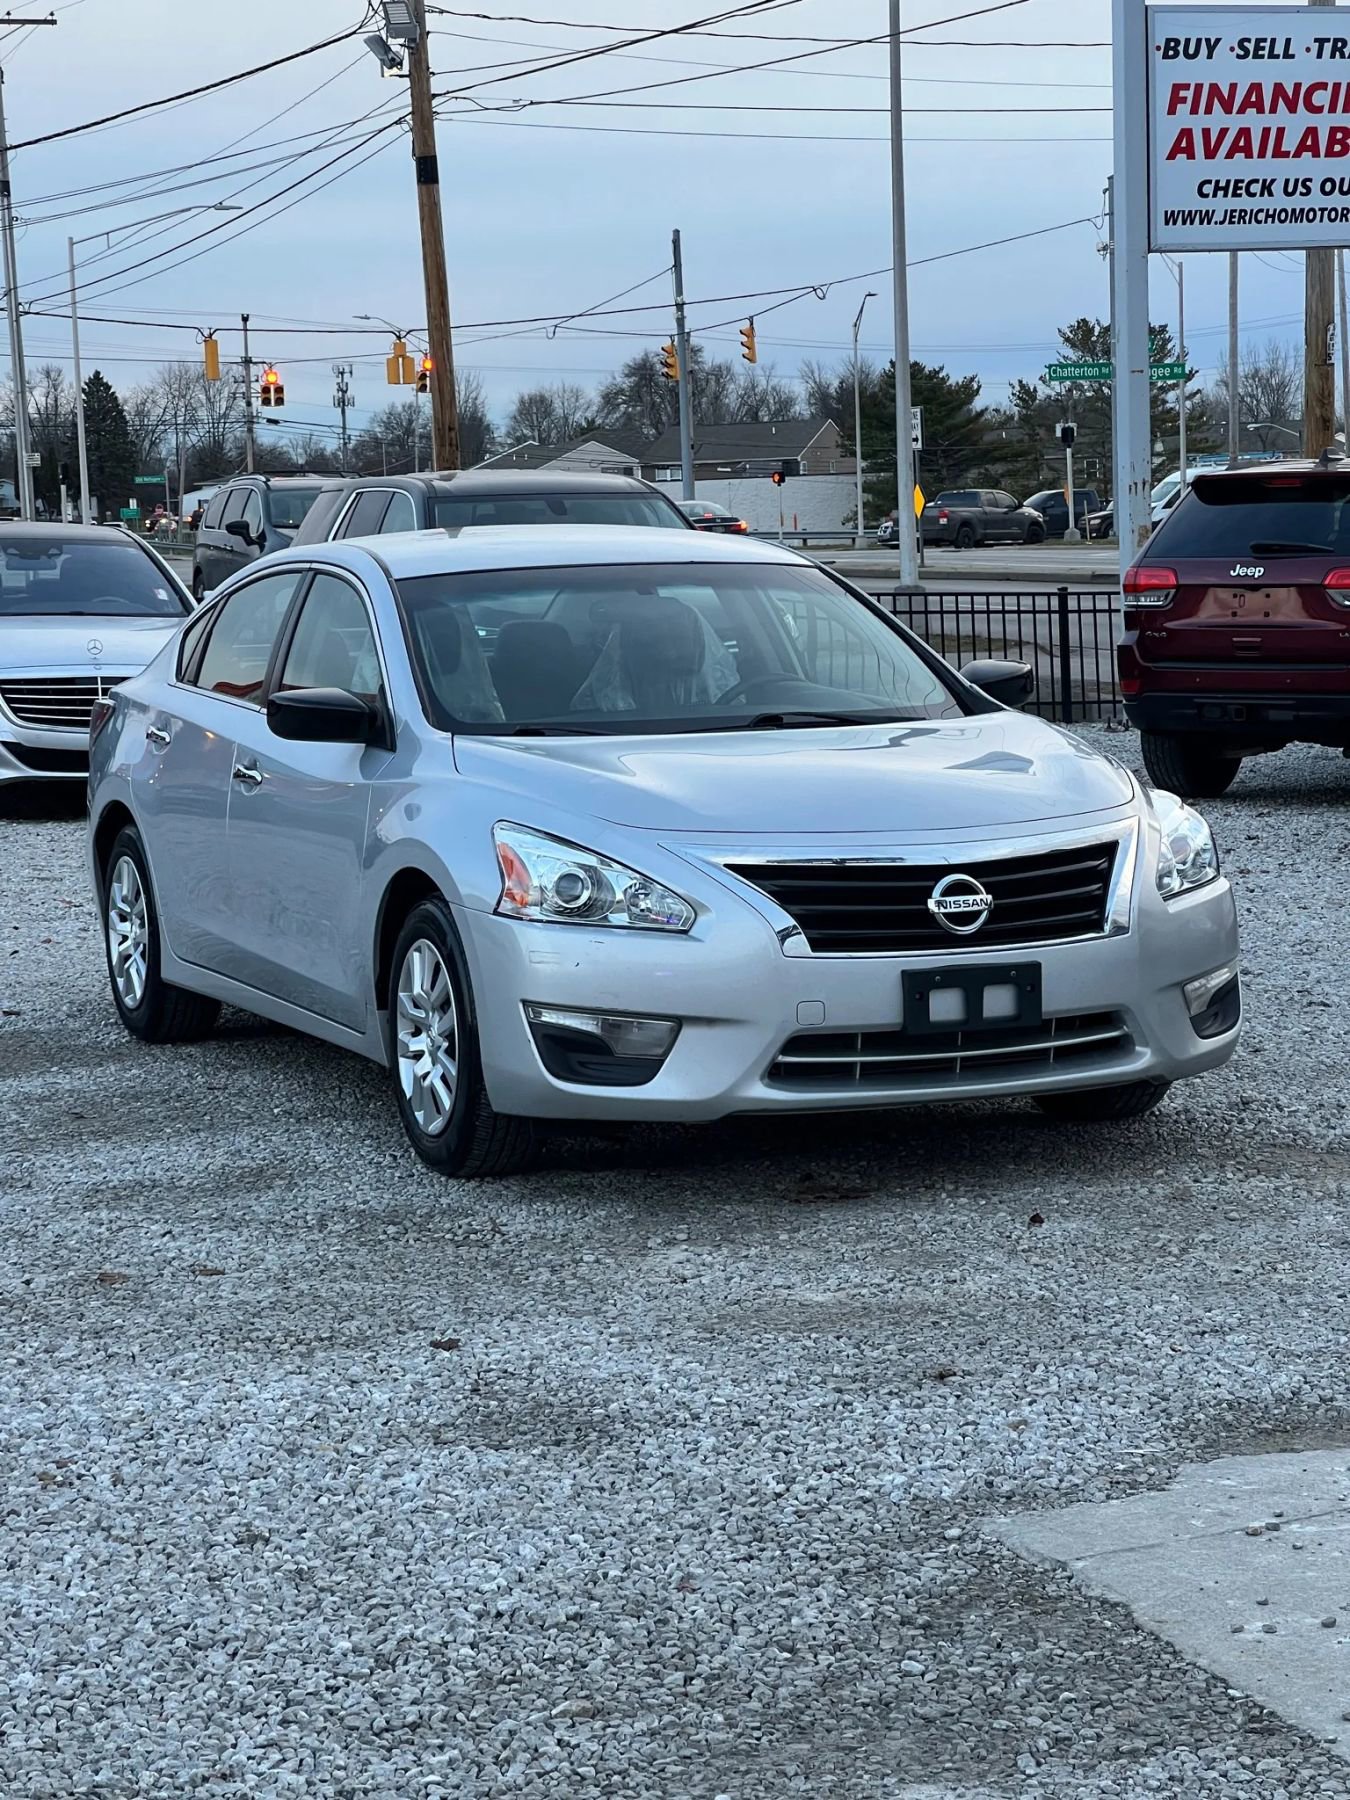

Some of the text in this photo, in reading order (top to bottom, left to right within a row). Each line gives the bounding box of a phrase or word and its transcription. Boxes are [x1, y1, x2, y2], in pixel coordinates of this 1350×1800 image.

[1313, 37, 1350, 60] TR
[1165, 126, 1350, 161] AVAILAB
[1197, 177, 1350, 199] CHECK US OU
[1164, 207, 1350, 226] WWW.JERICHOMOTOR
[1050, 366, 1099, 377] Chatterton
[1149, 367, 1171, 379] gee
[1230, 564, 1265, 578] Jeep
[936, 898, 989, 911] NISSAN
